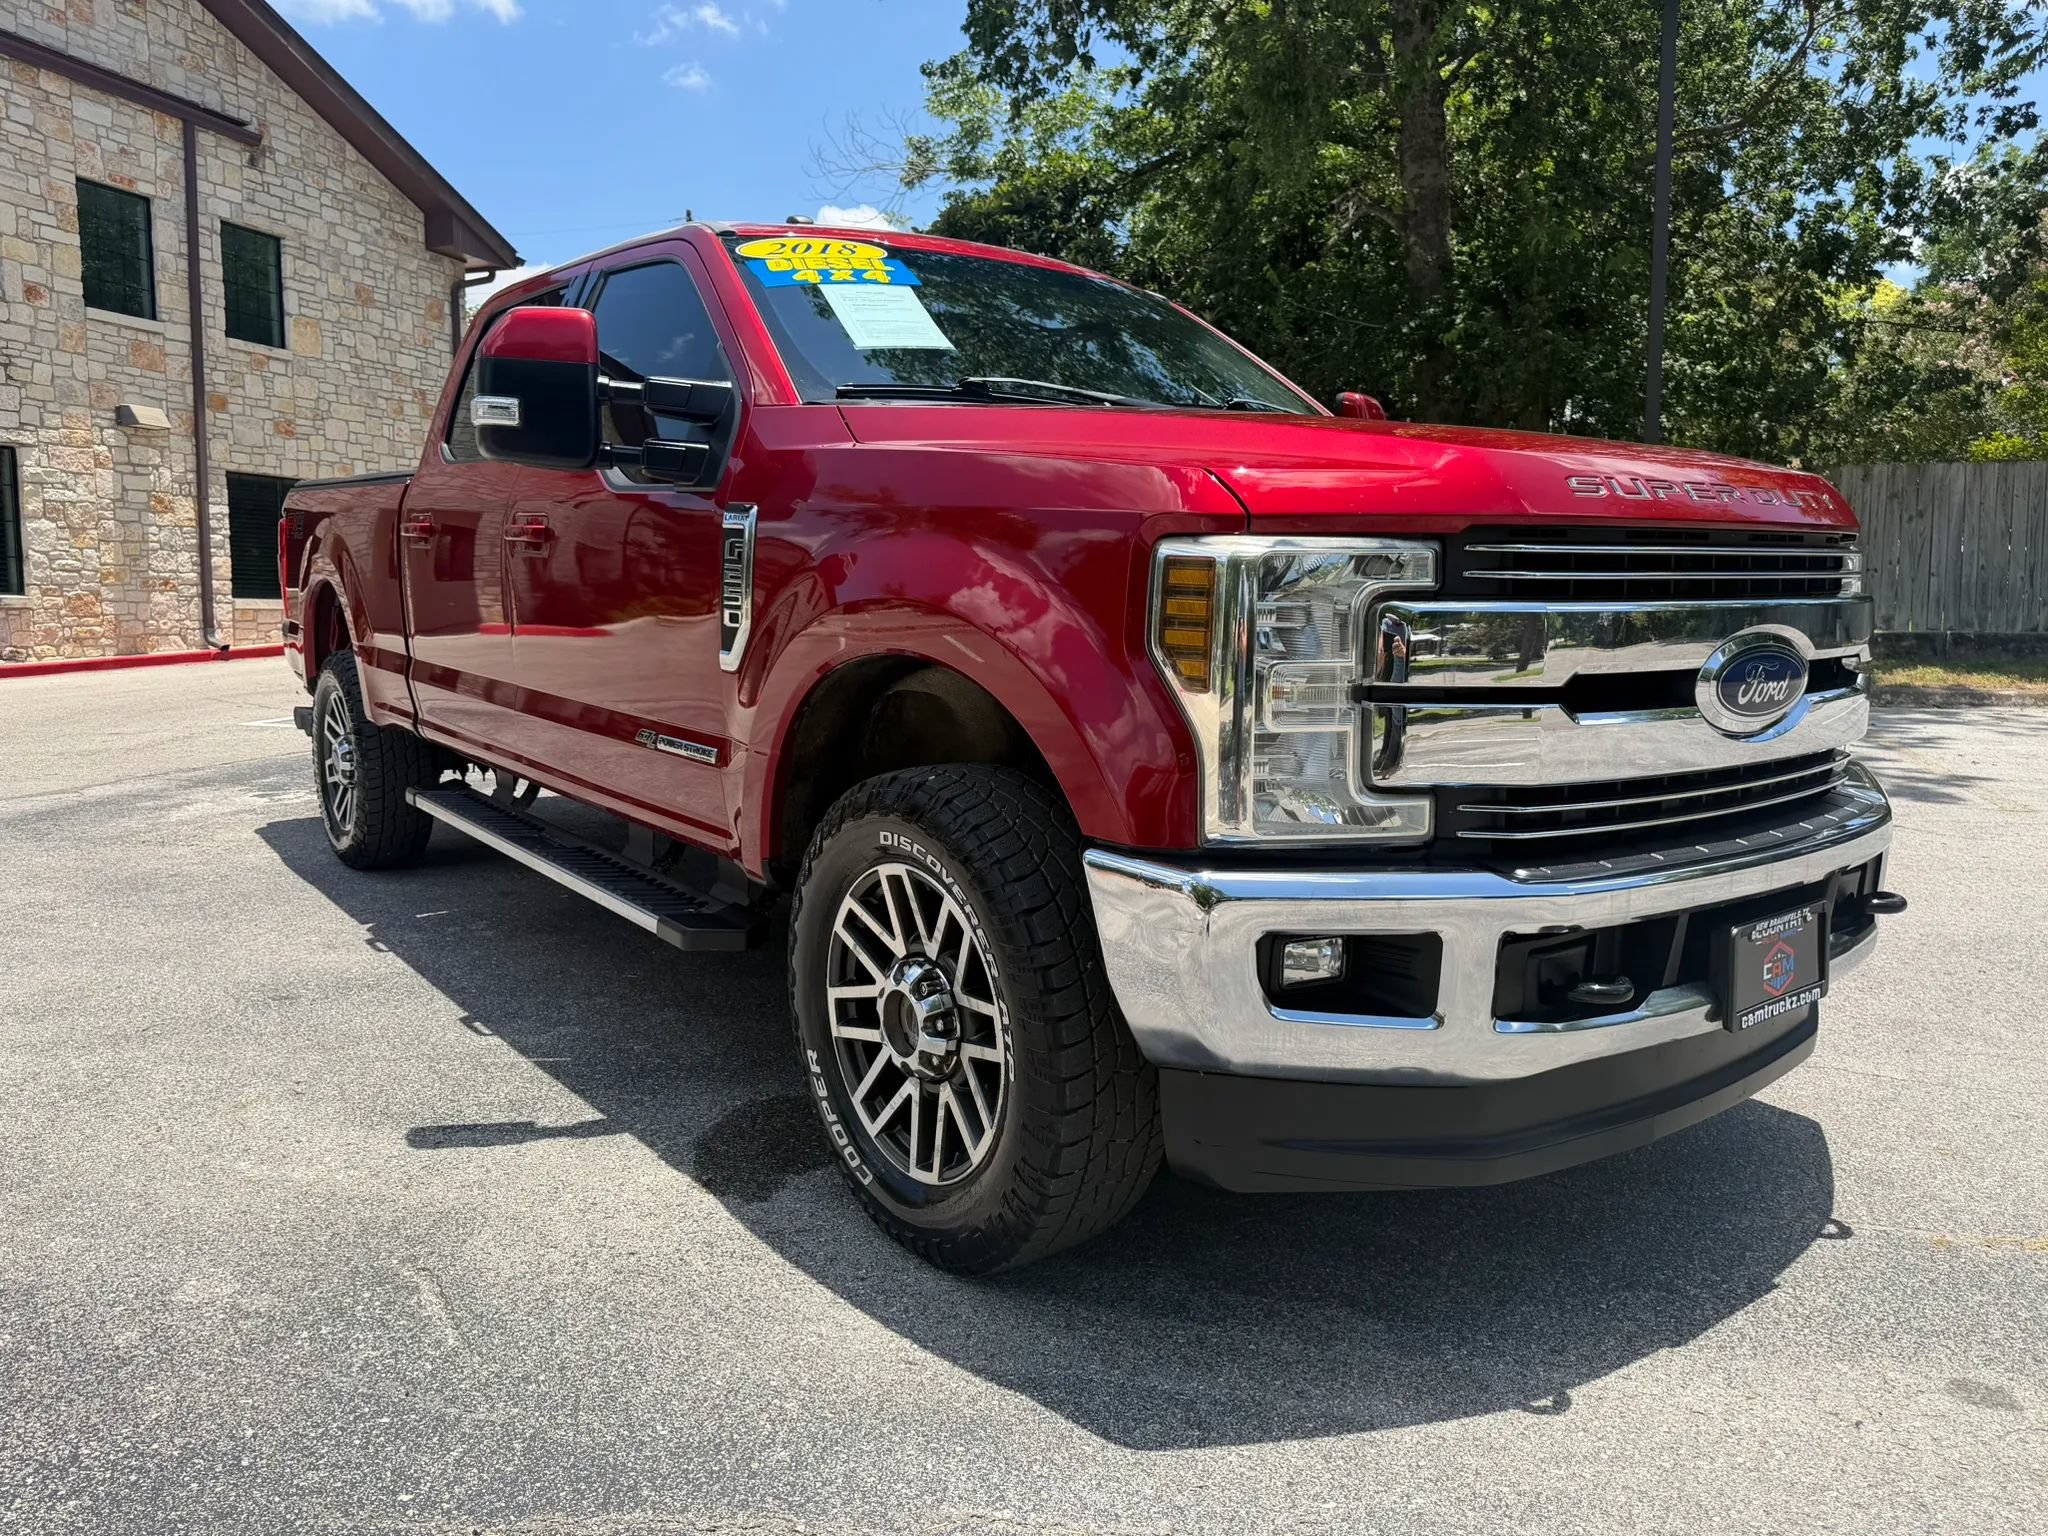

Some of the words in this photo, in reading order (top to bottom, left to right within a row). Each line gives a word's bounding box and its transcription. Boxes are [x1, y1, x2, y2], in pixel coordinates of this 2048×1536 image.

[765, 242, 858, 256] 2018
[765, 257, 895, 272] DIESEL
[1566, 475, 1746, 504] SUPER
[1746, 486, 1837, 511] DUTY
[724, 513, 749, 521] LARIAT
[1737, 661, 1791, 705] Ford
[658, 736, 683, 751] POWER
[683, 743, 714, 758] STROKE
[879, 831, 1000, 979] DISCOVERER
[1756, 920, 1770, 931] NEW
[1763, 957, 1795, 980] CAM
[1741, 987, 1822, 1029] camtruckz.com
[806, 1048, 873, 1188] COOPER
